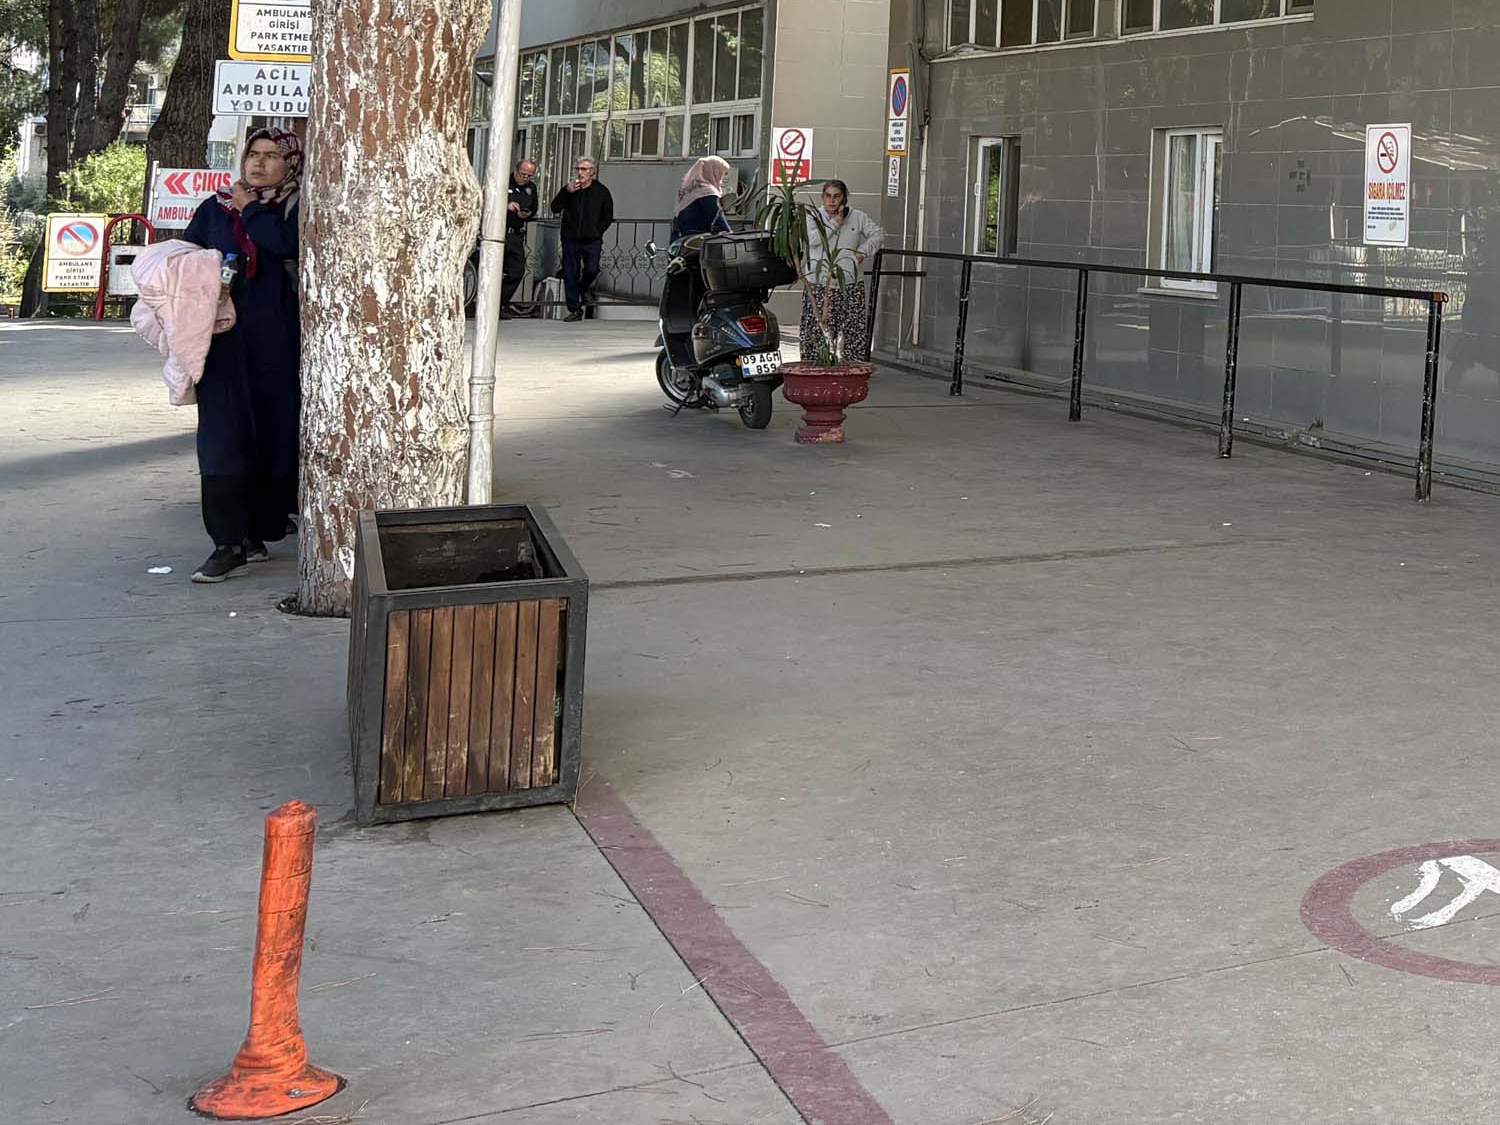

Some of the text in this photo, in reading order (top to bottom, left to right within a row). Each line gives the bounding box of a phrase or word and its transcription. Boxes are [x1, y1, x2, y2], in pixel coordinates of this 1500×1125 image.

[268, 19, 299, 30] GİRİŞİ
[250, 31, 279, 40] PARK
[257, 43, 308, 53] YASAKTIR
[255, 66, 300, 81] ACİL
[1368, 179, 1406, 203] SİGARA İÇİLMEZ
[742, 352, 780, 365] 09 AGM
[756, 363, 777, 374] 859
